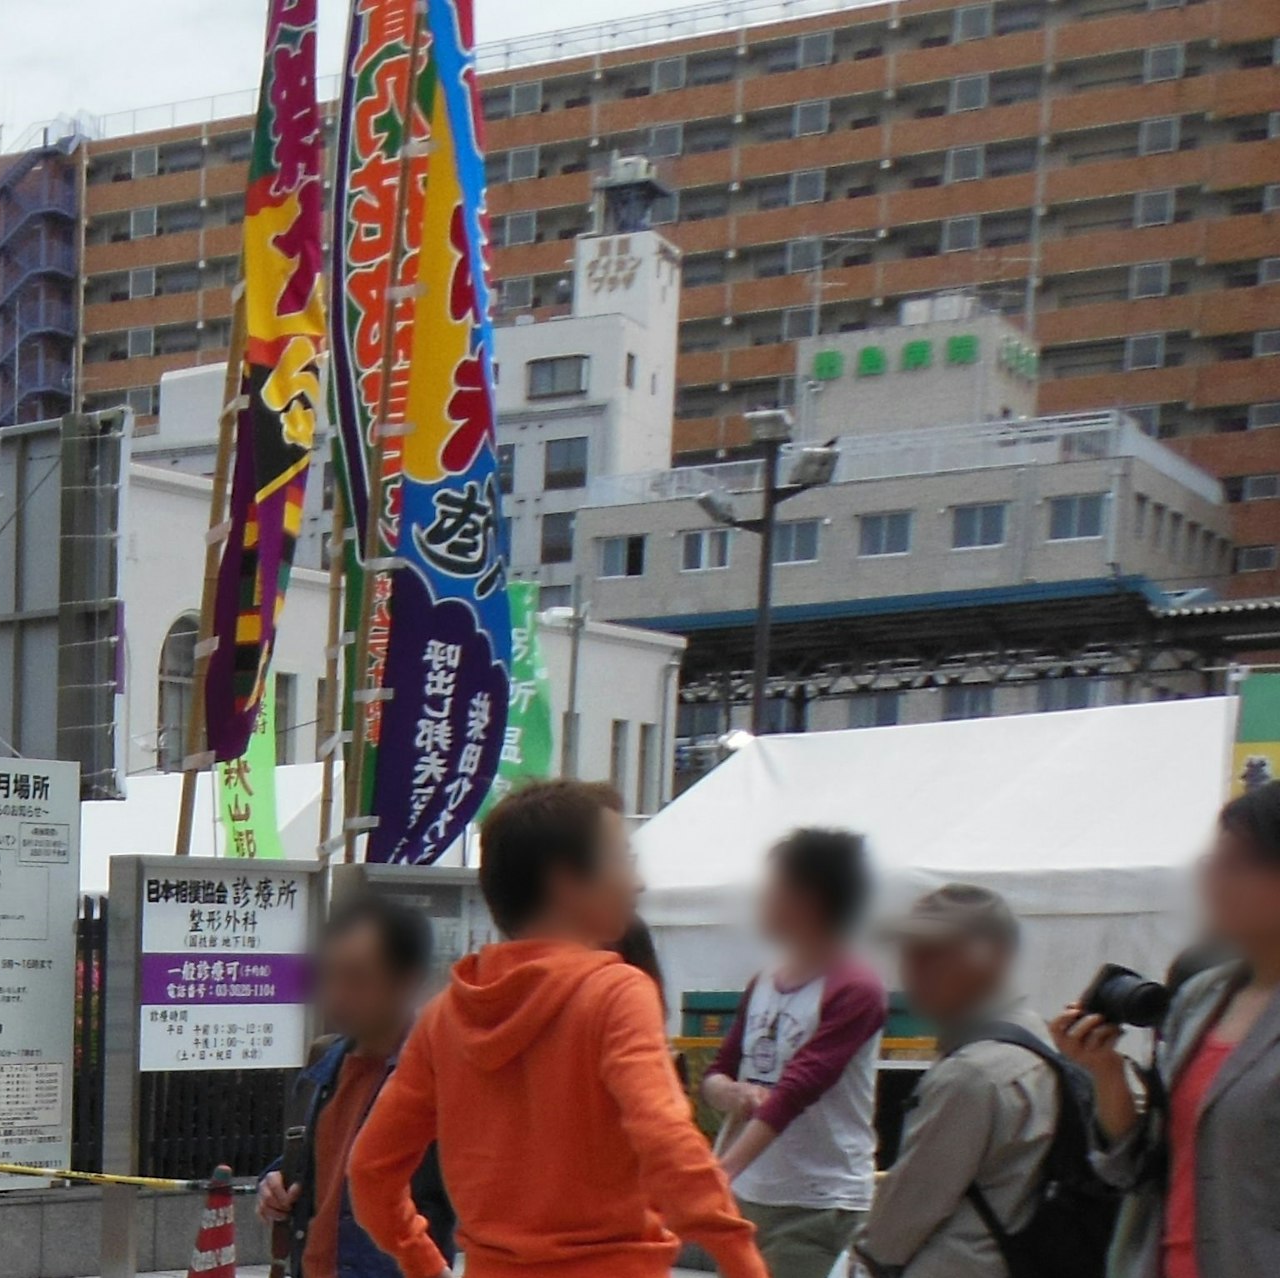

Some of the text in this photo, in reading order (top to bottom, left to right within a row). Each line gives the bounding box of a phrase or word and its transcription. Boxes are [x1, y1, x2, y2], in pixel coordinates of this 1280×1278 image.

[232, 876, 298, 911] 診療所
[189, 909, 258, 933] 整形外科
[150, 1009, 188, 1022] 診療時間
